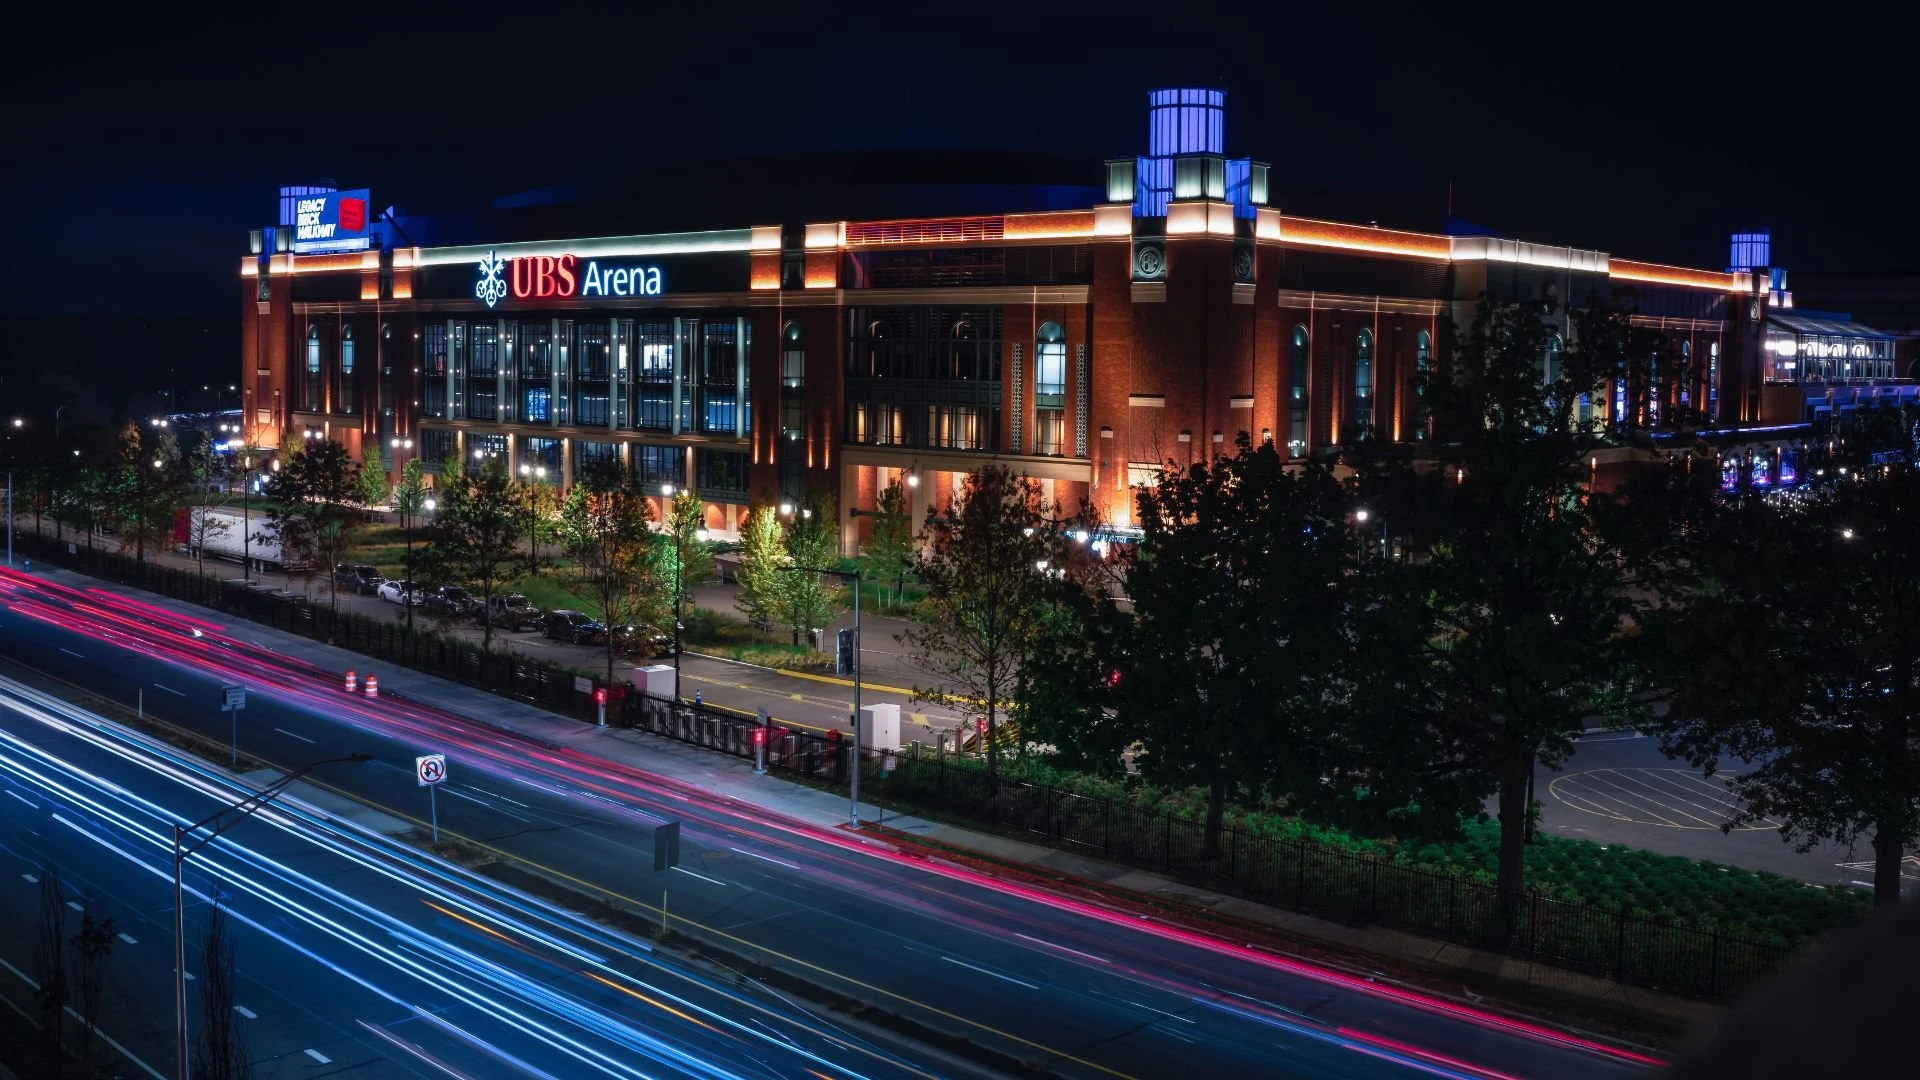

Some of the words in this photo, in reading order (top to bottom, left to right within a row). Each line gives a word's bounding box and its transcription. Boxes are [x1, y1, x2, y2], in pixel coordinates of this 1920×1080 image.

[297, 198, 327, 213] LEGACY
[512, 254, 575, 297] UBS
[583, 261, 662, 296] Arena
